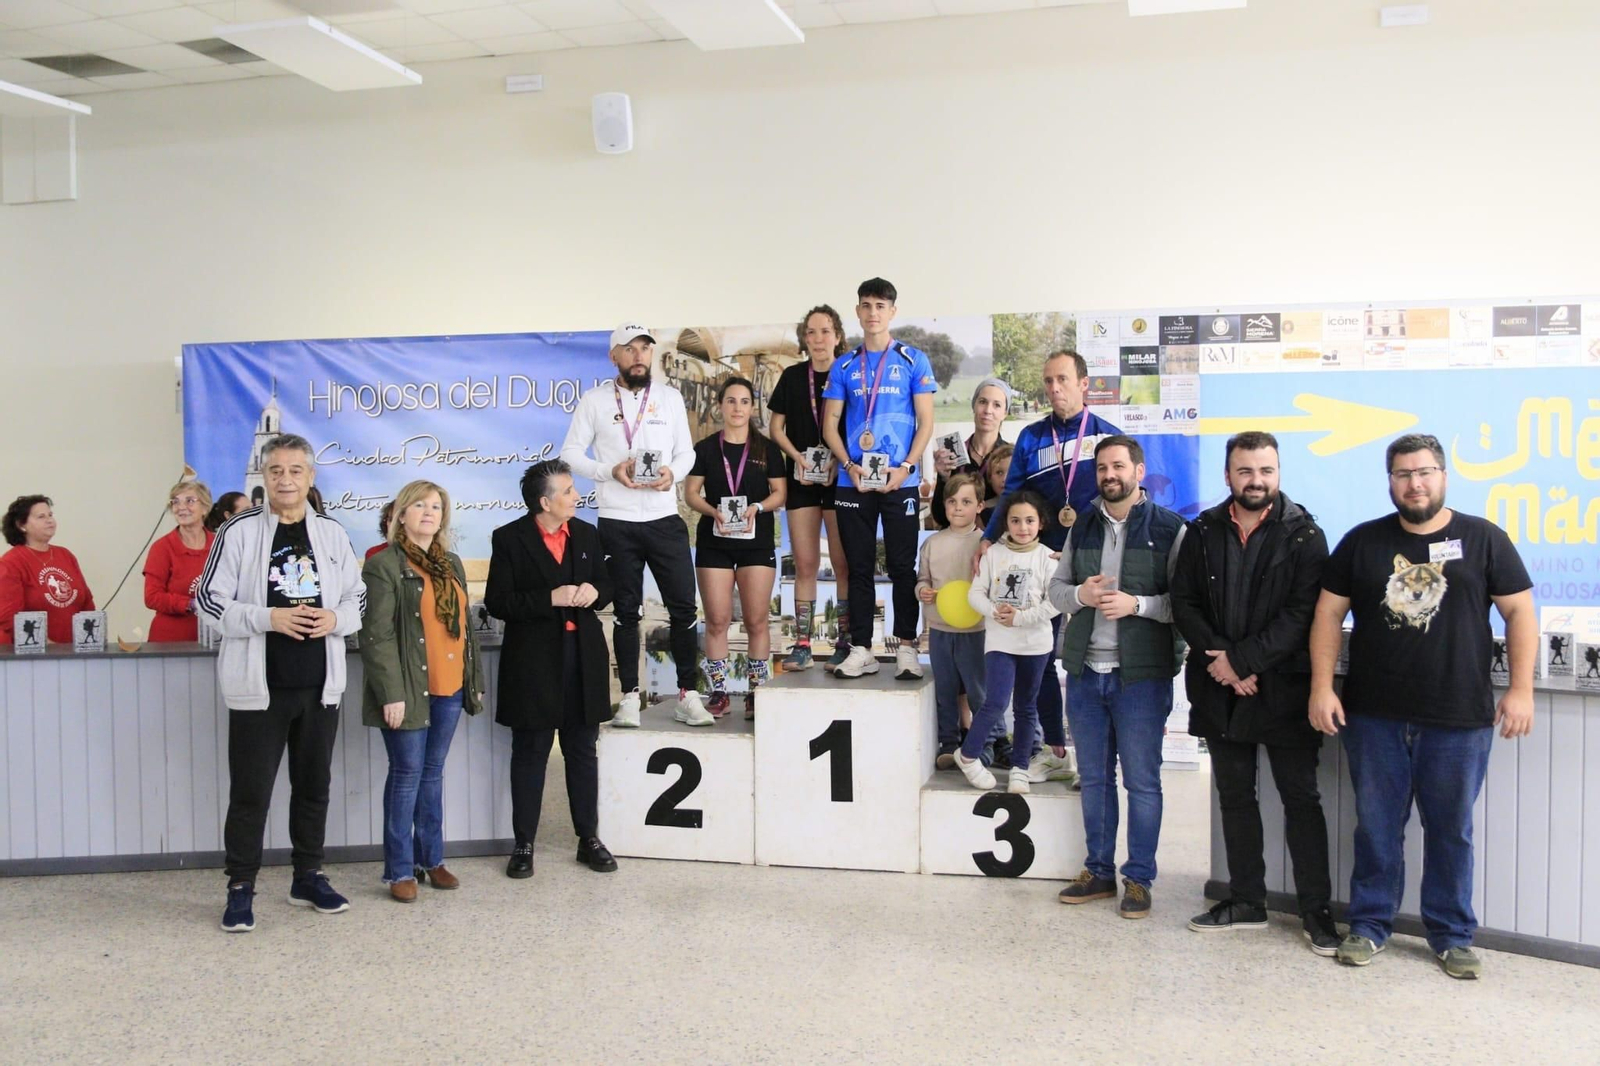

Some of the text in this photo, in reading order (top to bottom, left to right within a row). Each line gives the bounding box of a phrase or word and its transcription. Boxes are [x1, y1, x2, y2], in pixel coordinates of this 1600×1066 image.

[309, 379, 440, 417] Hinojosa
[448, 375, 497, 409] del
[1163, 408, 1198, 420] AMG
[314, 434, 562, 466] Ciudad Patrimonial
[644, 746, 704, 829] 2
[808, 719, 854, 803] 1
[972, 791, 1035, 878] 3
